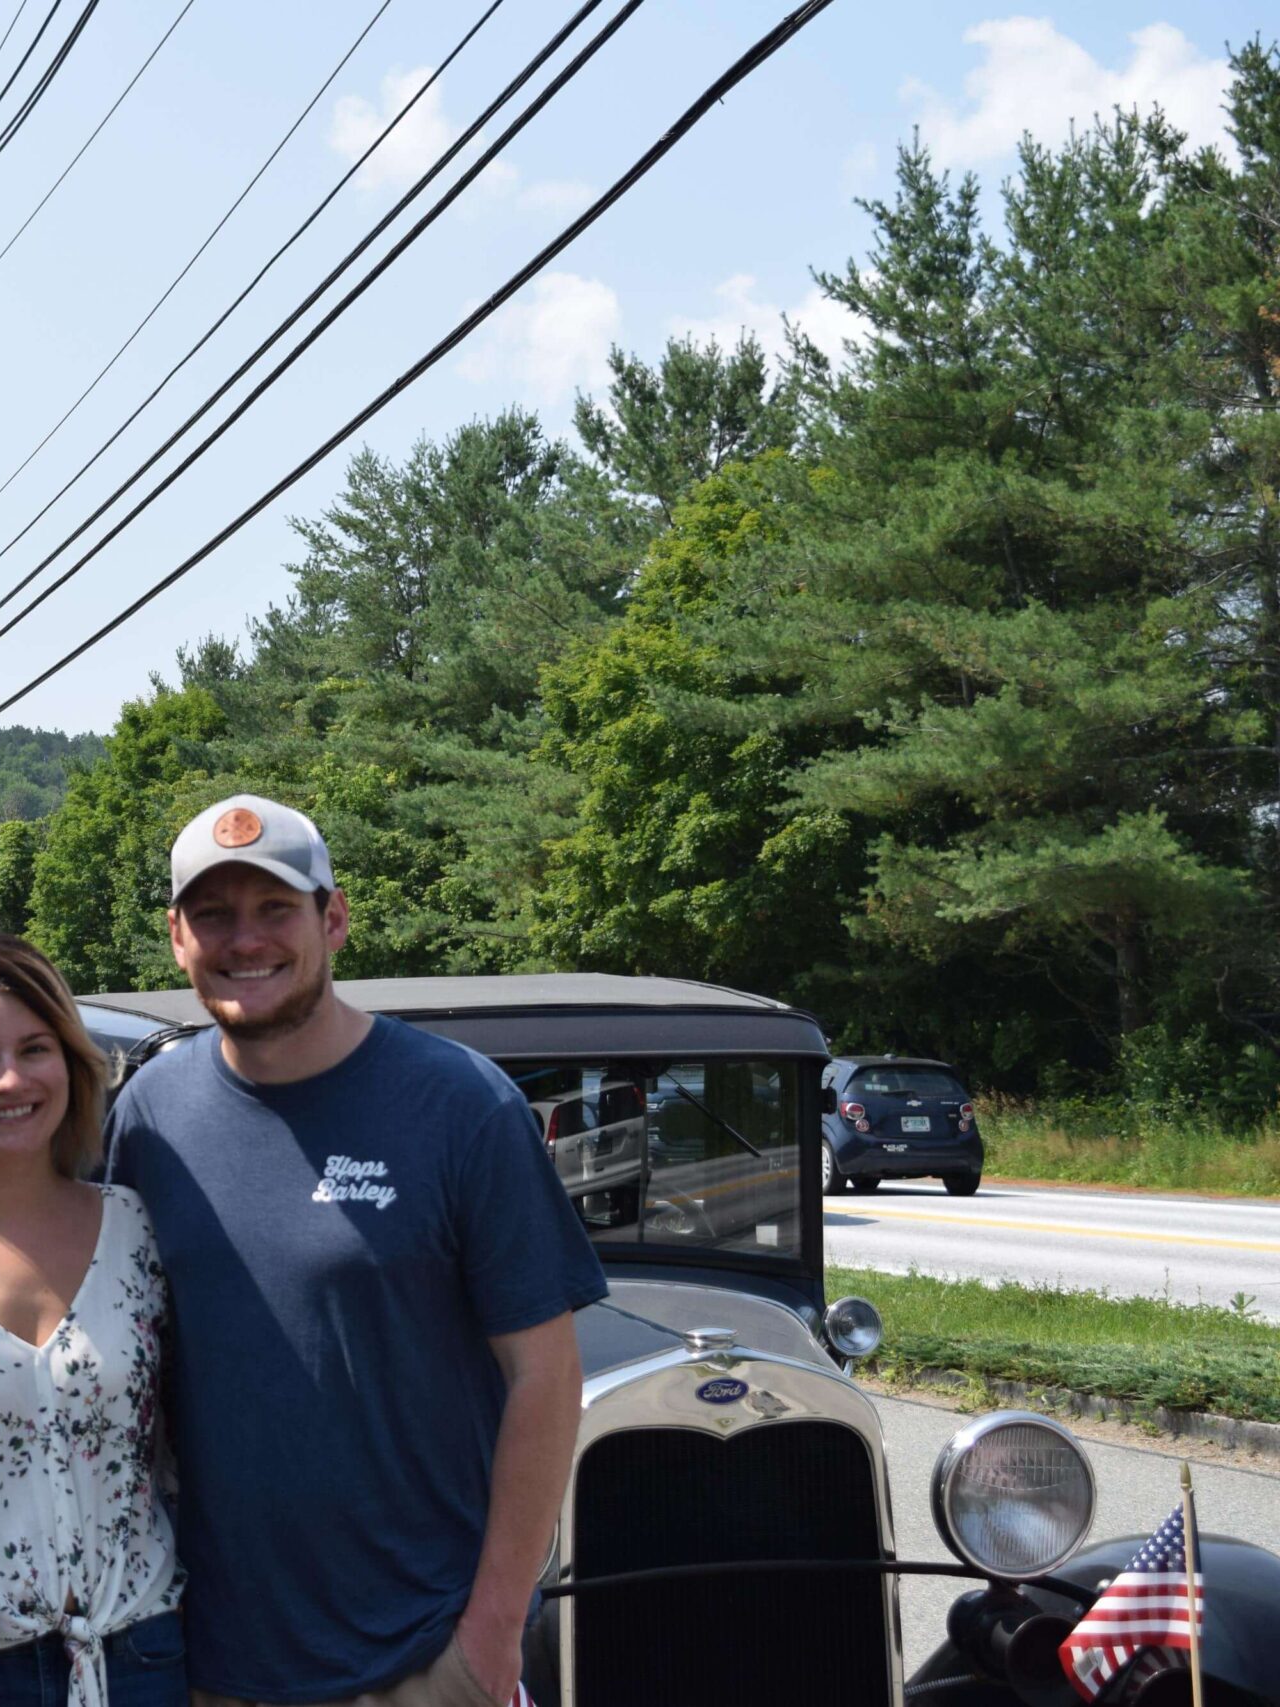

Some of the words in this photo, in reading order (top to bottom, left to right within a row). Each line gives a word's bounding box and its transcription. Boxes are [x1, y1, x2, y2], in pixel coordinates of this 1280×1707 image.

[324, 1155, 388, 1180] Hops
[311, 1177, 397, 1210] Barley
[703, 1382, 742, 1398] Ford
